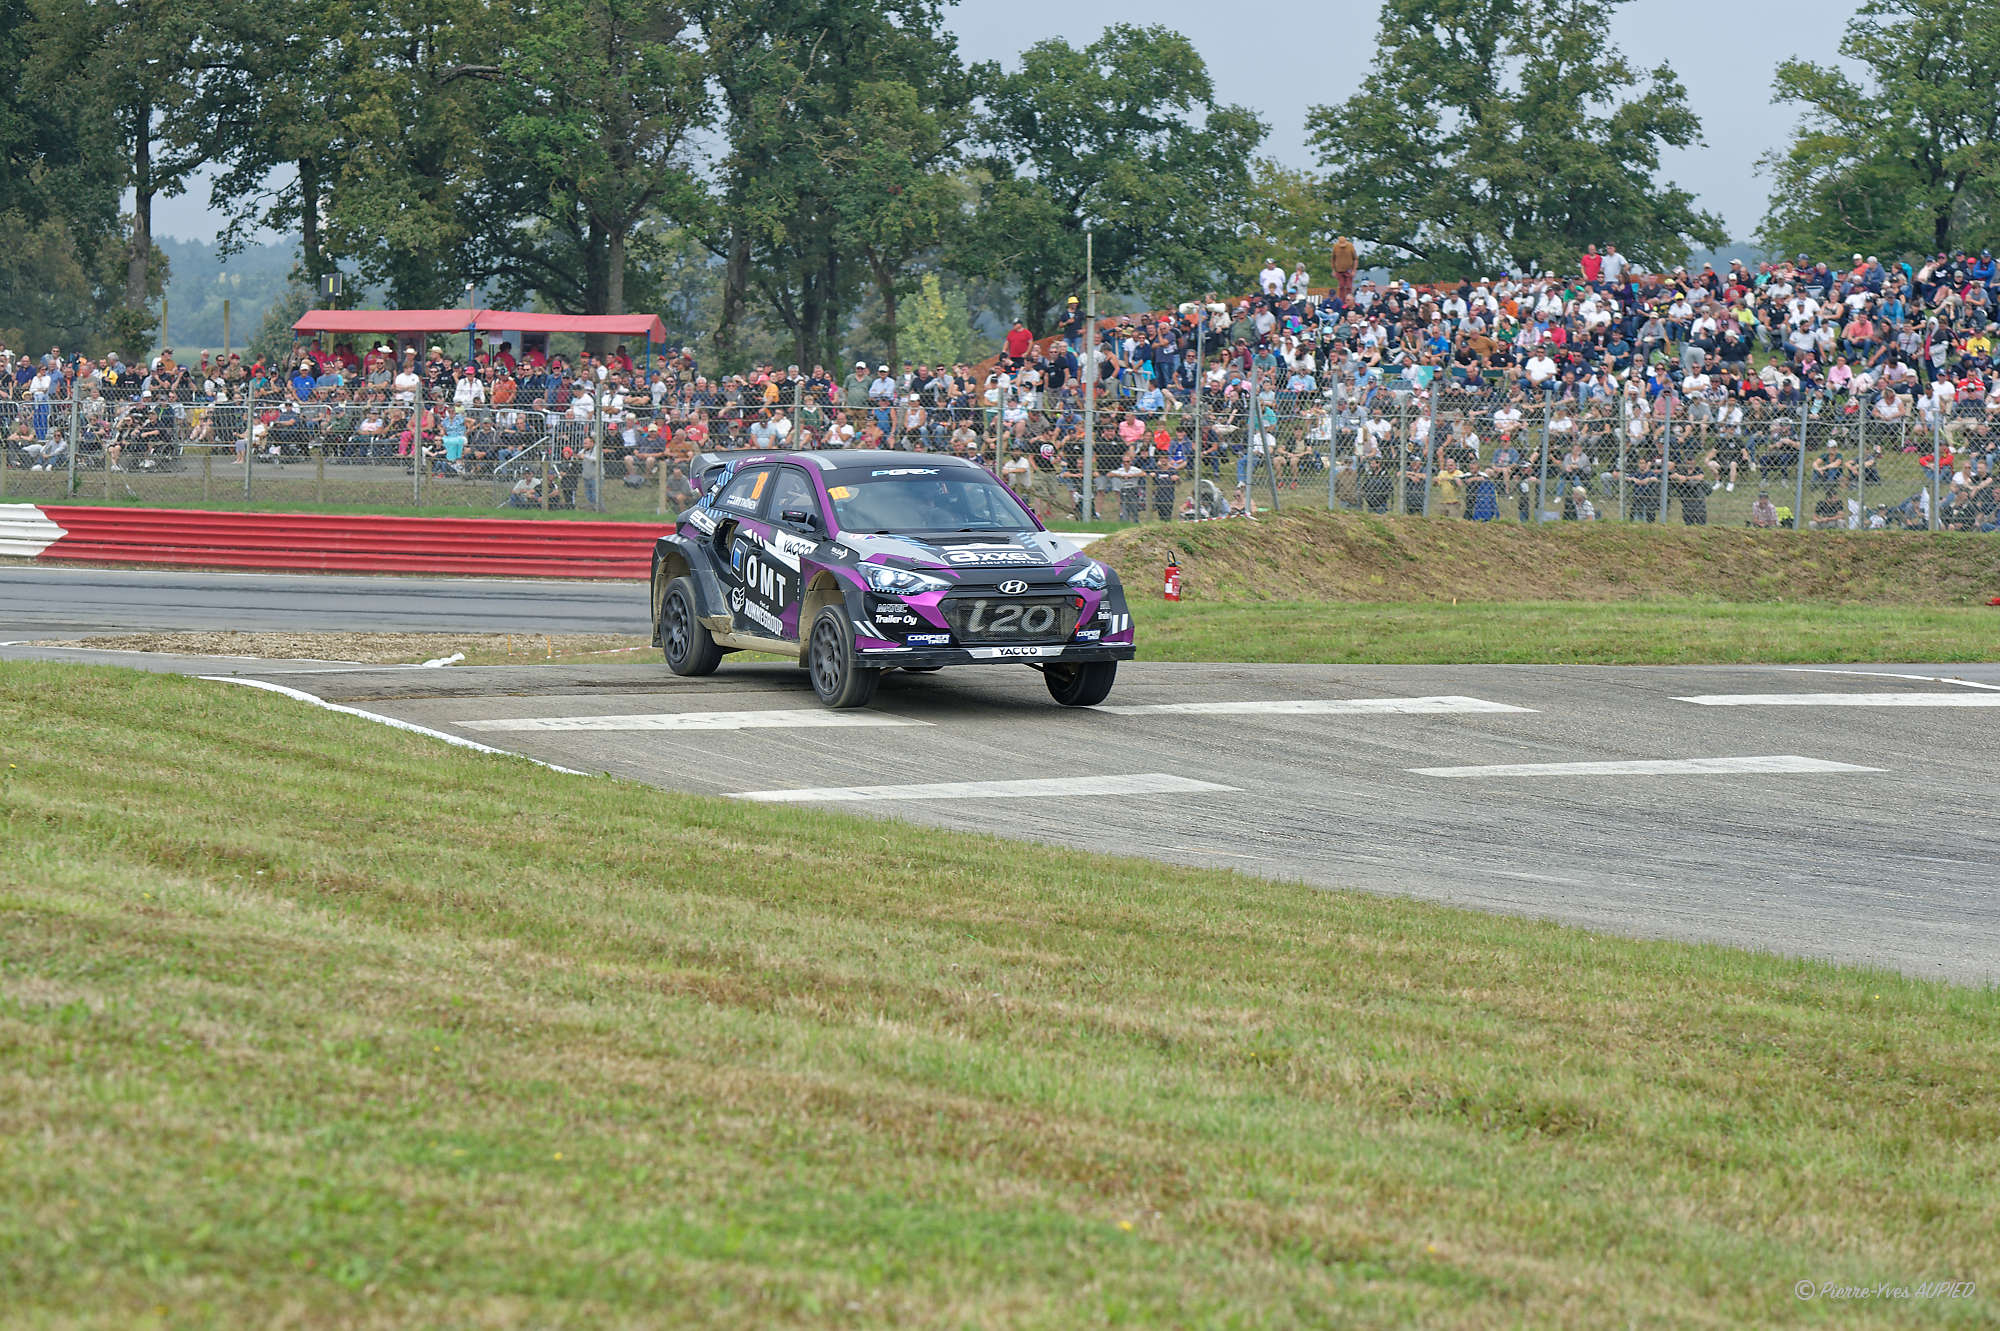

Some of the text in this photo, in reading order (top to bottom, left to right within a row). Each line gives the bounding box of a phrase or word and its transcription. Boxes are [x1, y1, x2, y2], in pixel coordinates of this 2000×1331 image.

[783, 540, 812, 556] YACCO
[746, 554, 787, 608] OMT
[875, 614, 918, 626] Trailer Oy
[999, 647, 1038, 656] YACCO
